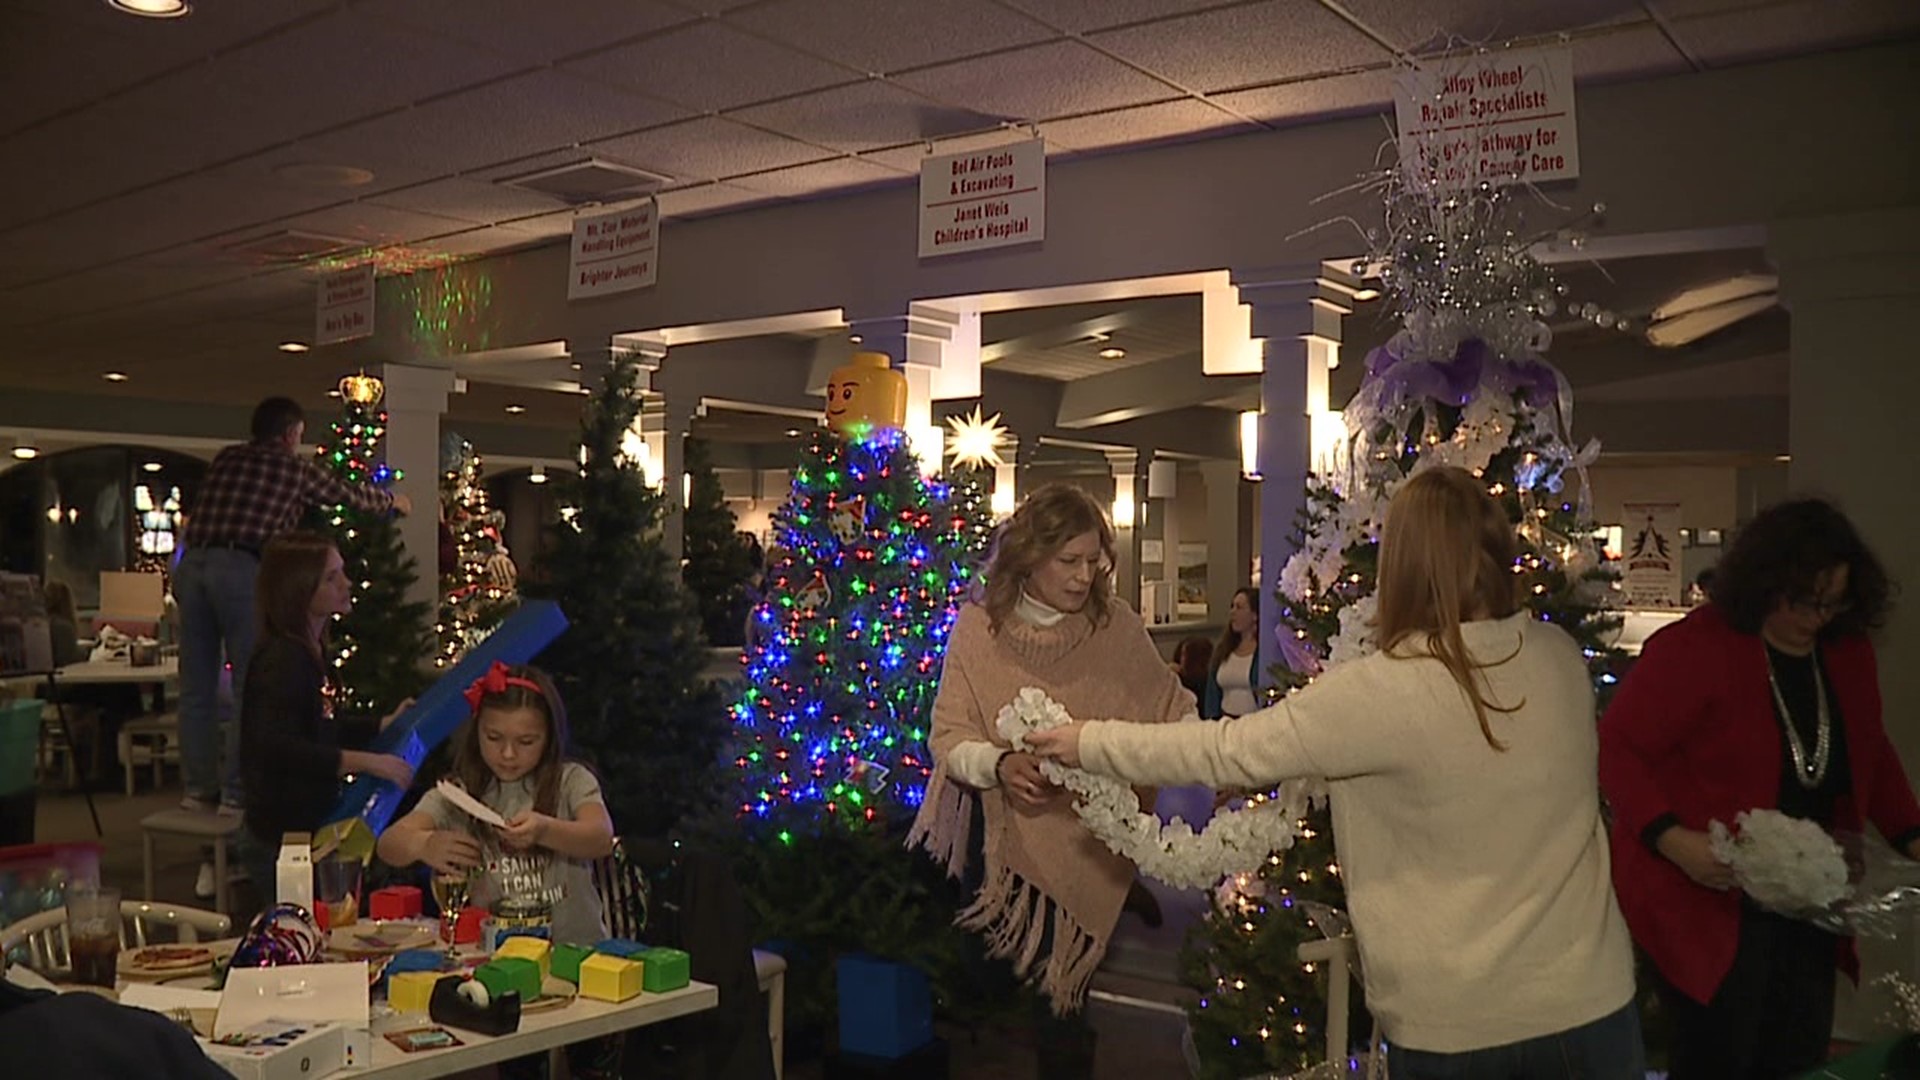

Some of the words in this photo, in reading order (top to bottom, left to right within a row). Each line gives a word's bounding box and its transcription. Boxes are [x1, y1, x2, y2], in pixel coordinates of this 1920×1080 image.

[1478, 66, 1522, 88] Wheel
[1470, 90, 1548, 118] Specialists
[1478, 130, 1533, 153] athway
[1536, 128, 1557, 147] for
[952, 159, 968, 176] Bel
[970, 157, 985, 173] Air
[986, 152, 1013, 170] Pools
[1531, 153, 1565, 172] Care
[951, 181, 958, 195] &
[961, 173, 1014, 194] Excavating
[953, 205, 982, 223] Janet
[984, 201, 1009, 218] Weis
[934, 226, 984, 245] Children's
[986, 217, 1028, 239] Hospital
[580, 268, 613, 287] Brighter
[614, 262, 647, 279] Journeys
[513, 873, 542, 893] CAN
